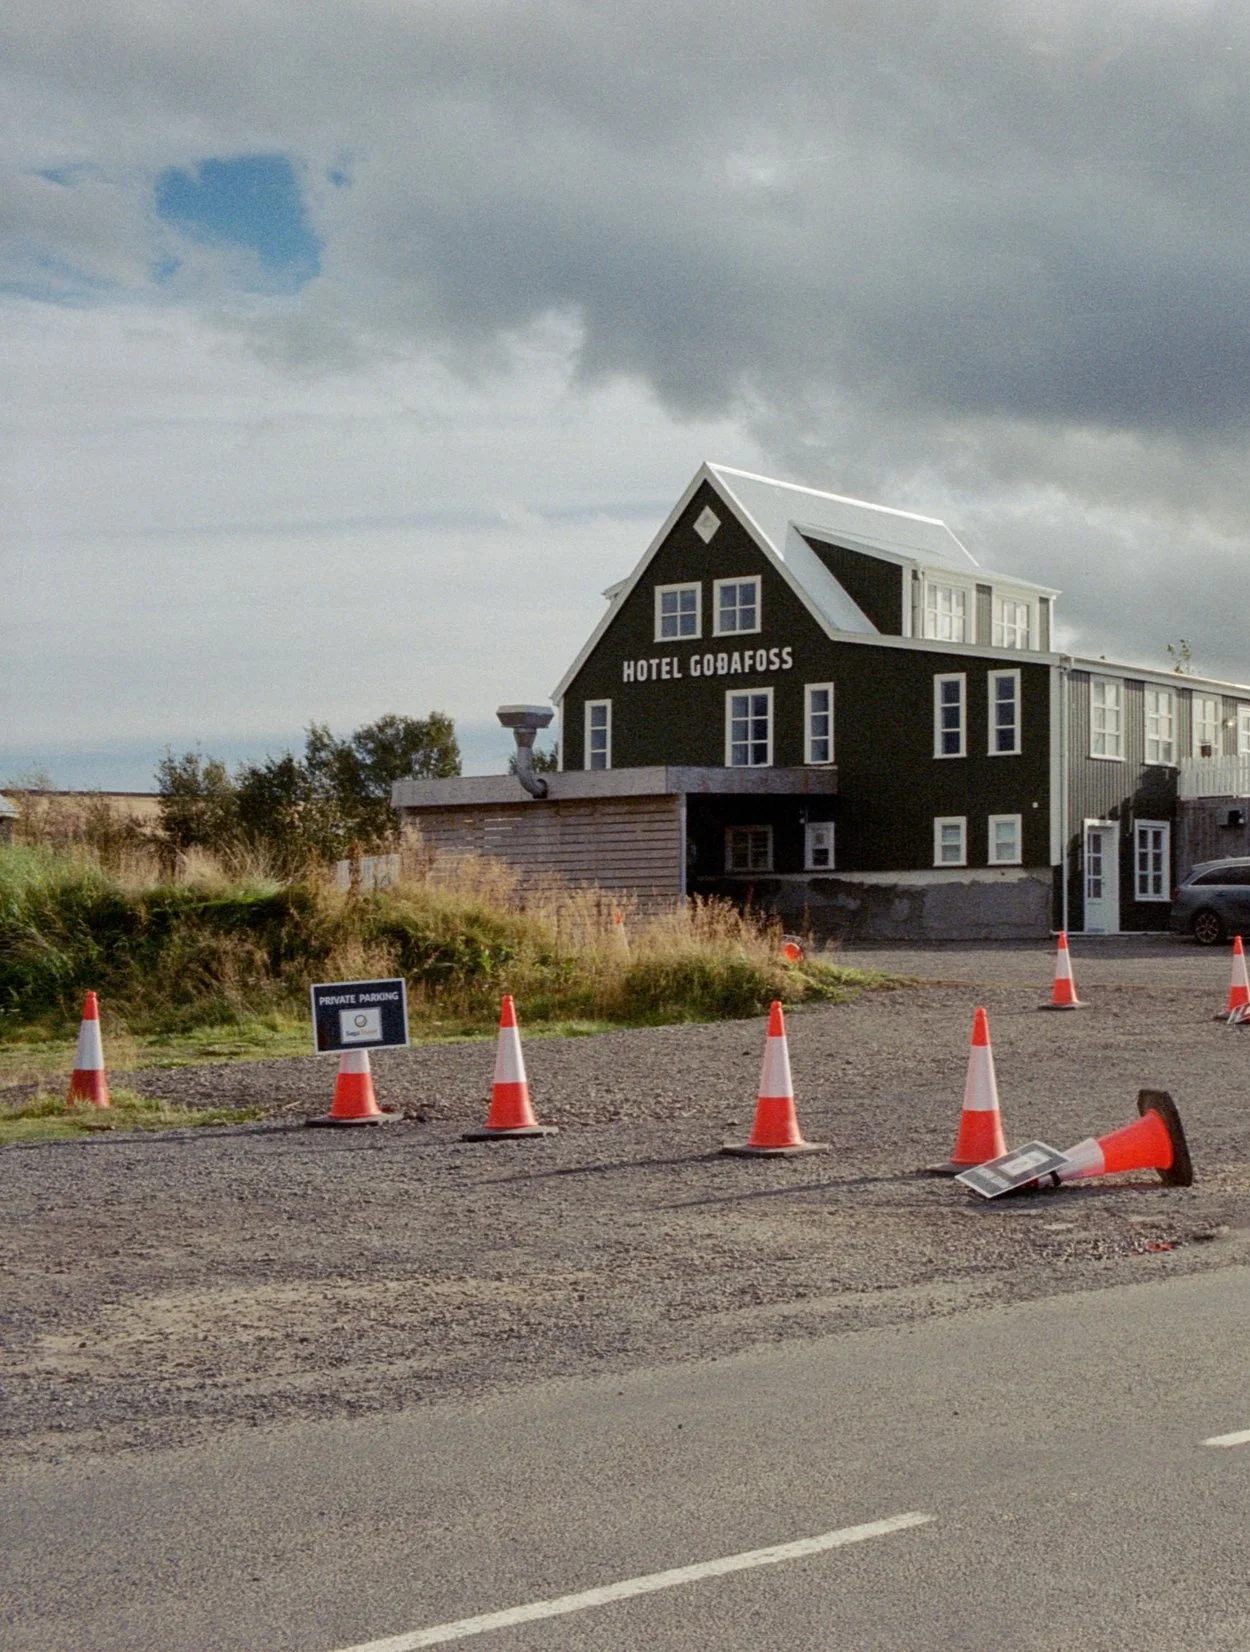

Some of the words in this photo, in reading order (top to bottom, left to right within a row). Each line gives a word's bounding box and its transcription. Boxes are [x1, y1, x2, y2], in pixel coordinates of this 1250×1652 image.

[623, 657, 682, 683] HOTEL
[690, 646, 793, 677] GOÐAFOSS
[318, 994, 356, 1006] PRIVATE
[359, 991, 399, 1003] PARKING
